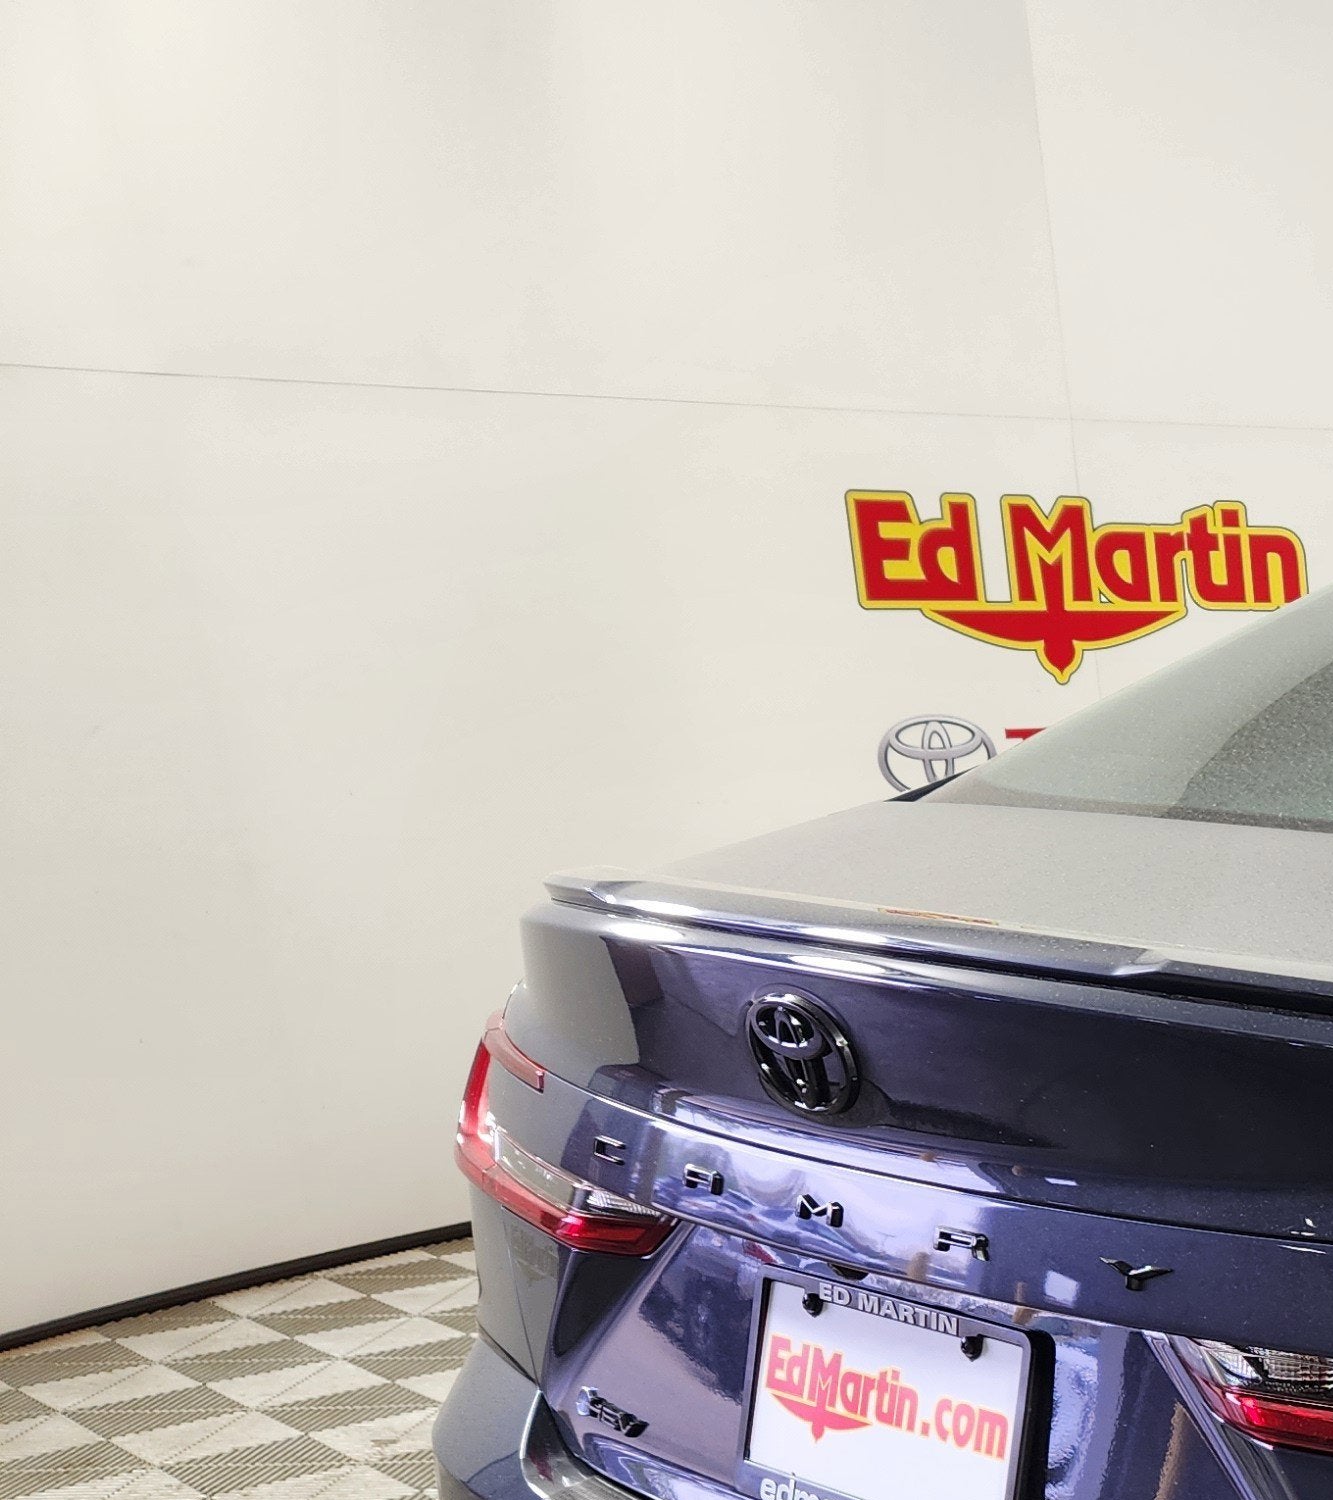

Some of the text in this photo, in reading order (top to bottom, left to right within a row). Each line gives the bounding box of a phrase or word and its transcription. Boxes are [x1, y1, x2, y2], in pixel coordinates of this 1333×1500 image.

[845, 489, 1308, 611] Ed Martin
[592, 1133, 1175, 1293] CAMRY
[818, 1281, 960, 1337] ED MARTIN
